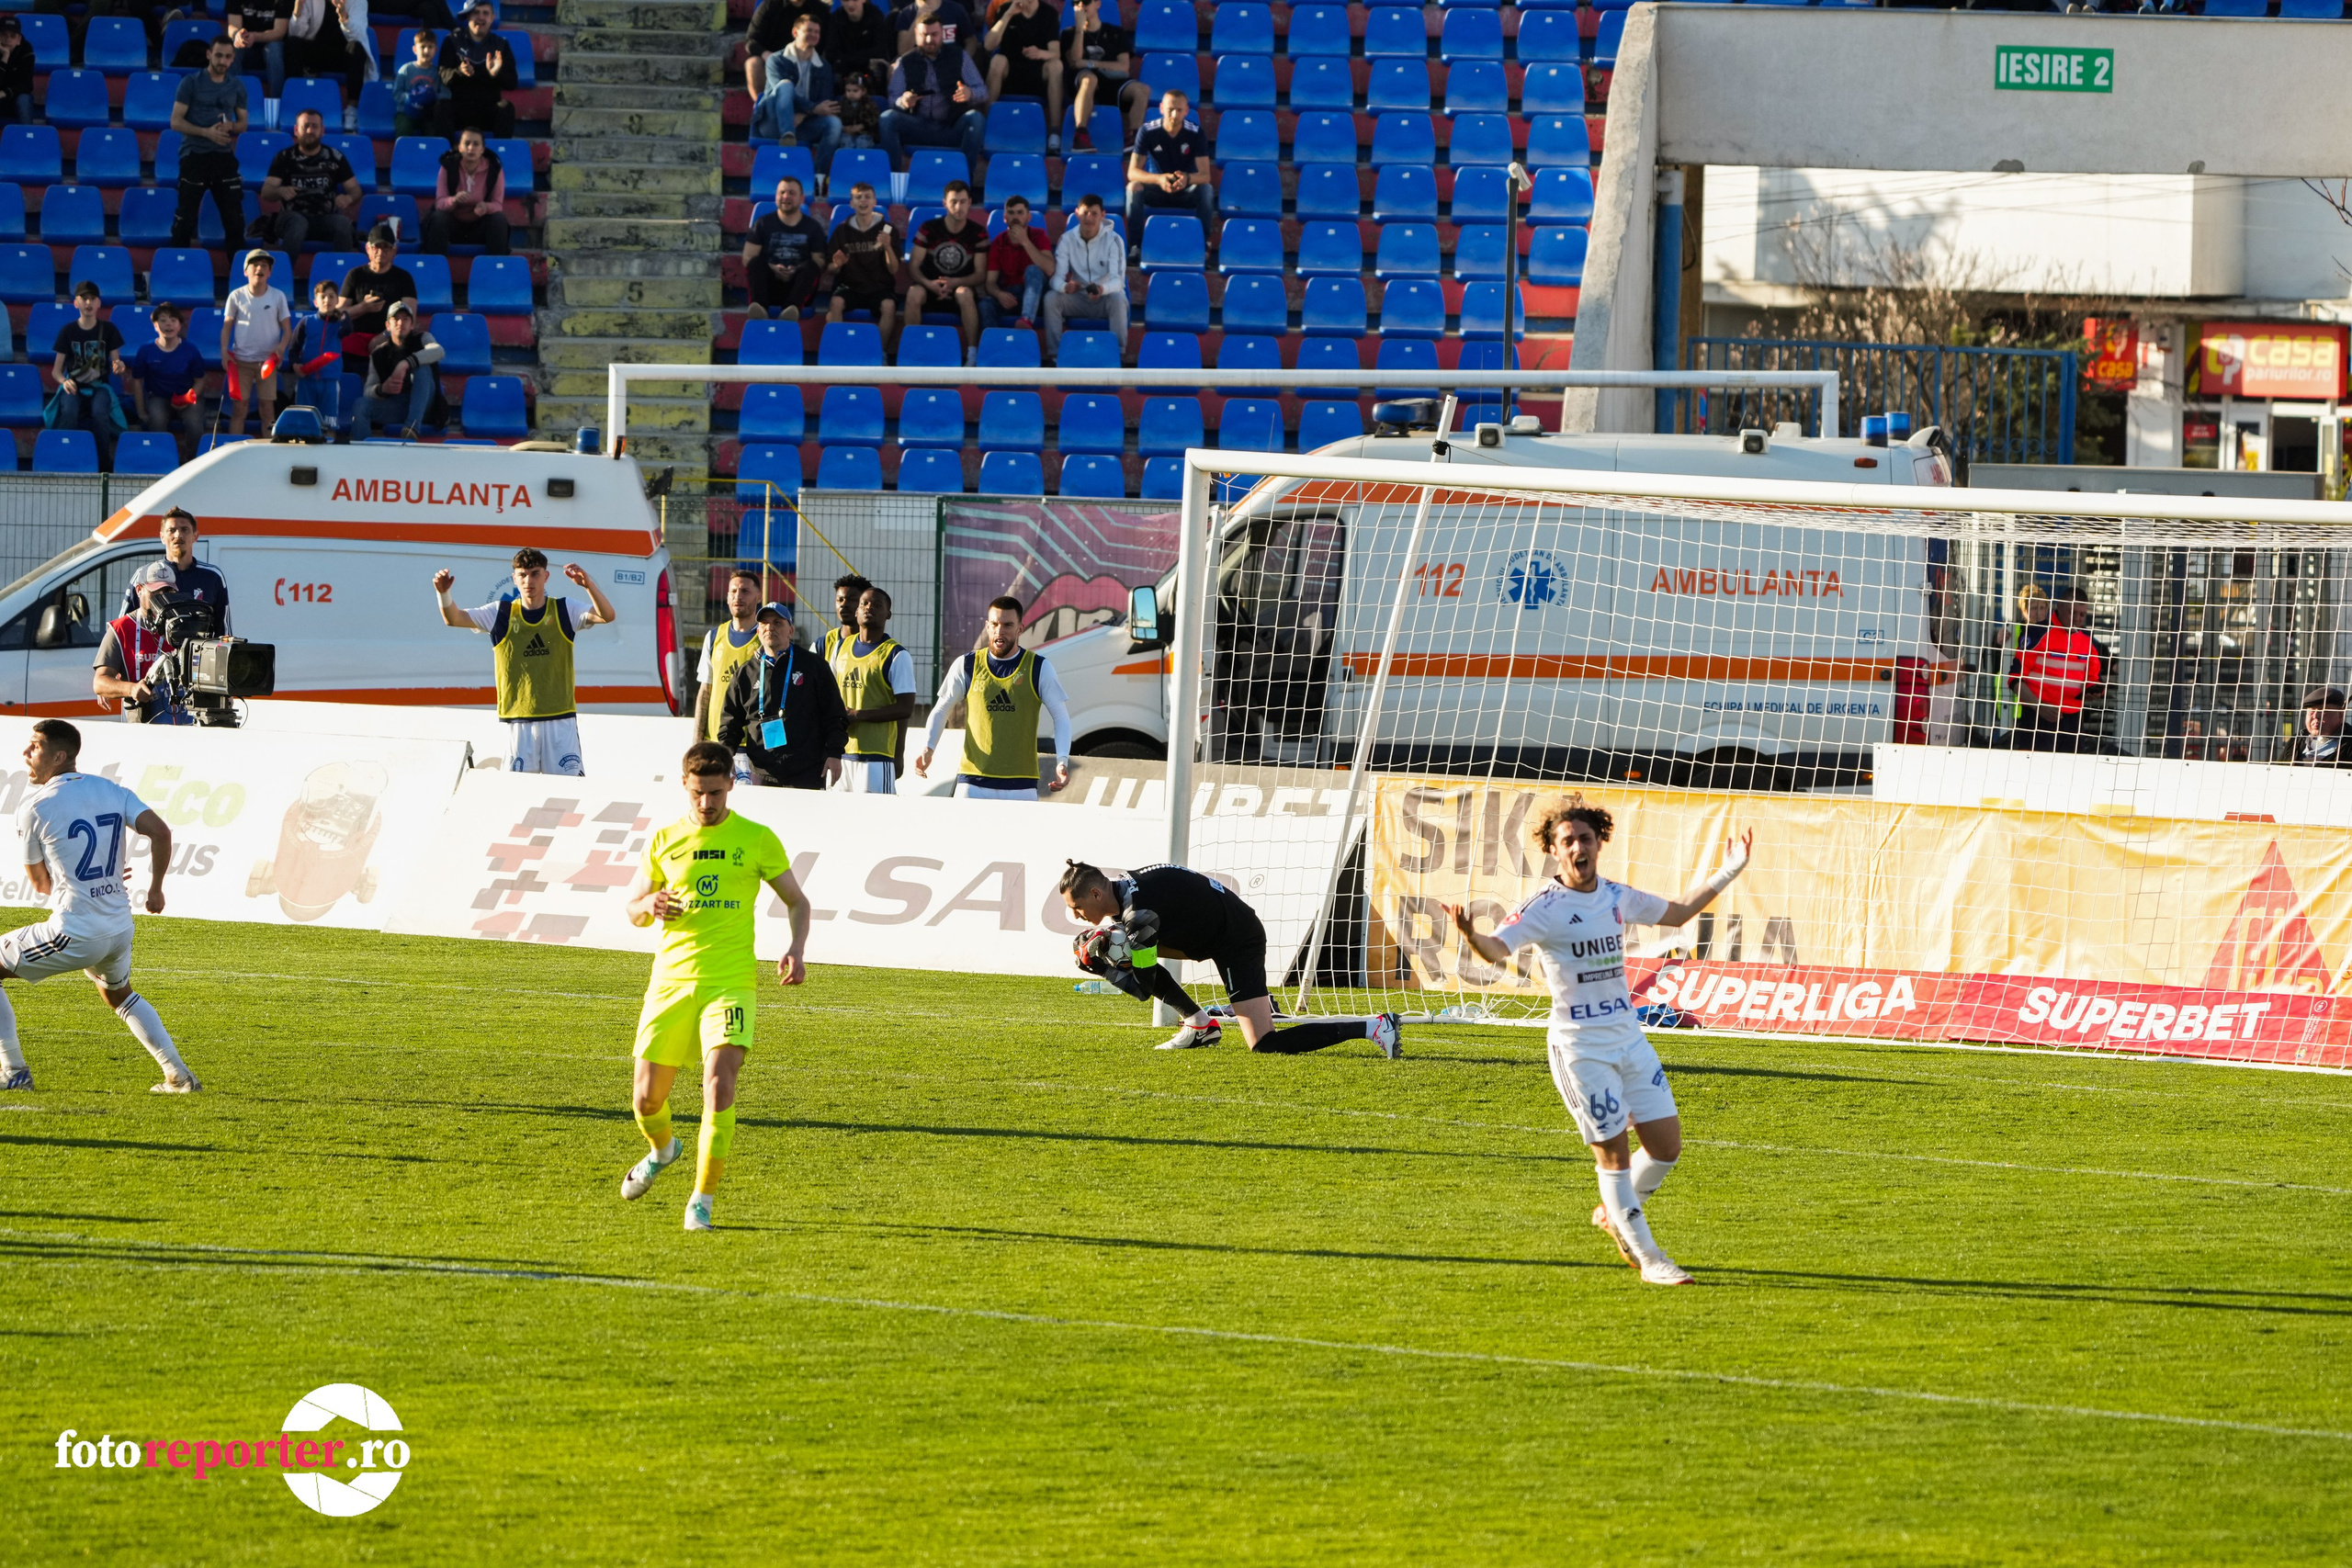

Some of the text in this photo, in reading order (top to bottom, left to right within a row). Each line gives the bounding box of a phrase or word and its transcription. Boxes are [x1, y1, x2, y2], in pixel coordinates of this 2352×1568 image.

[1999, 52, 2109, 85] IESIRE 2
[628, 281, 643, 303] 5
[2249, 334, 2335, 367] casa
[2098, 361, 2134, 378] casa
[2245, 367, 2333, 383] pariurilor.ro
[616, 572, 643, 582] B1/B2
[1414, 562, 1466, 597] 112
[288, 581, 333, 604] 112
[523, 647, 550, 658] adidas
[986, 702, 1016, 713] adidas
[1753, 702, 1804, 714] MEDICAL
[1806, 703, 1823, 714] DE
[1826, 703, 1881, 715] URGENTA
[138, 764, 246, 829] Eco
[68, 812, 122, 882] 27
[724, 901, 741, 909] BET
[1571, 933, 1623, 959] UNIBE
[1646, 964, 1917, 1021] SUPERLIGA
[1570, 998, 1633, 1021] ELSA
[2018, 987, 2272, 1042] SUPERBET
[1590, 1088, 1620, 1122] 66
